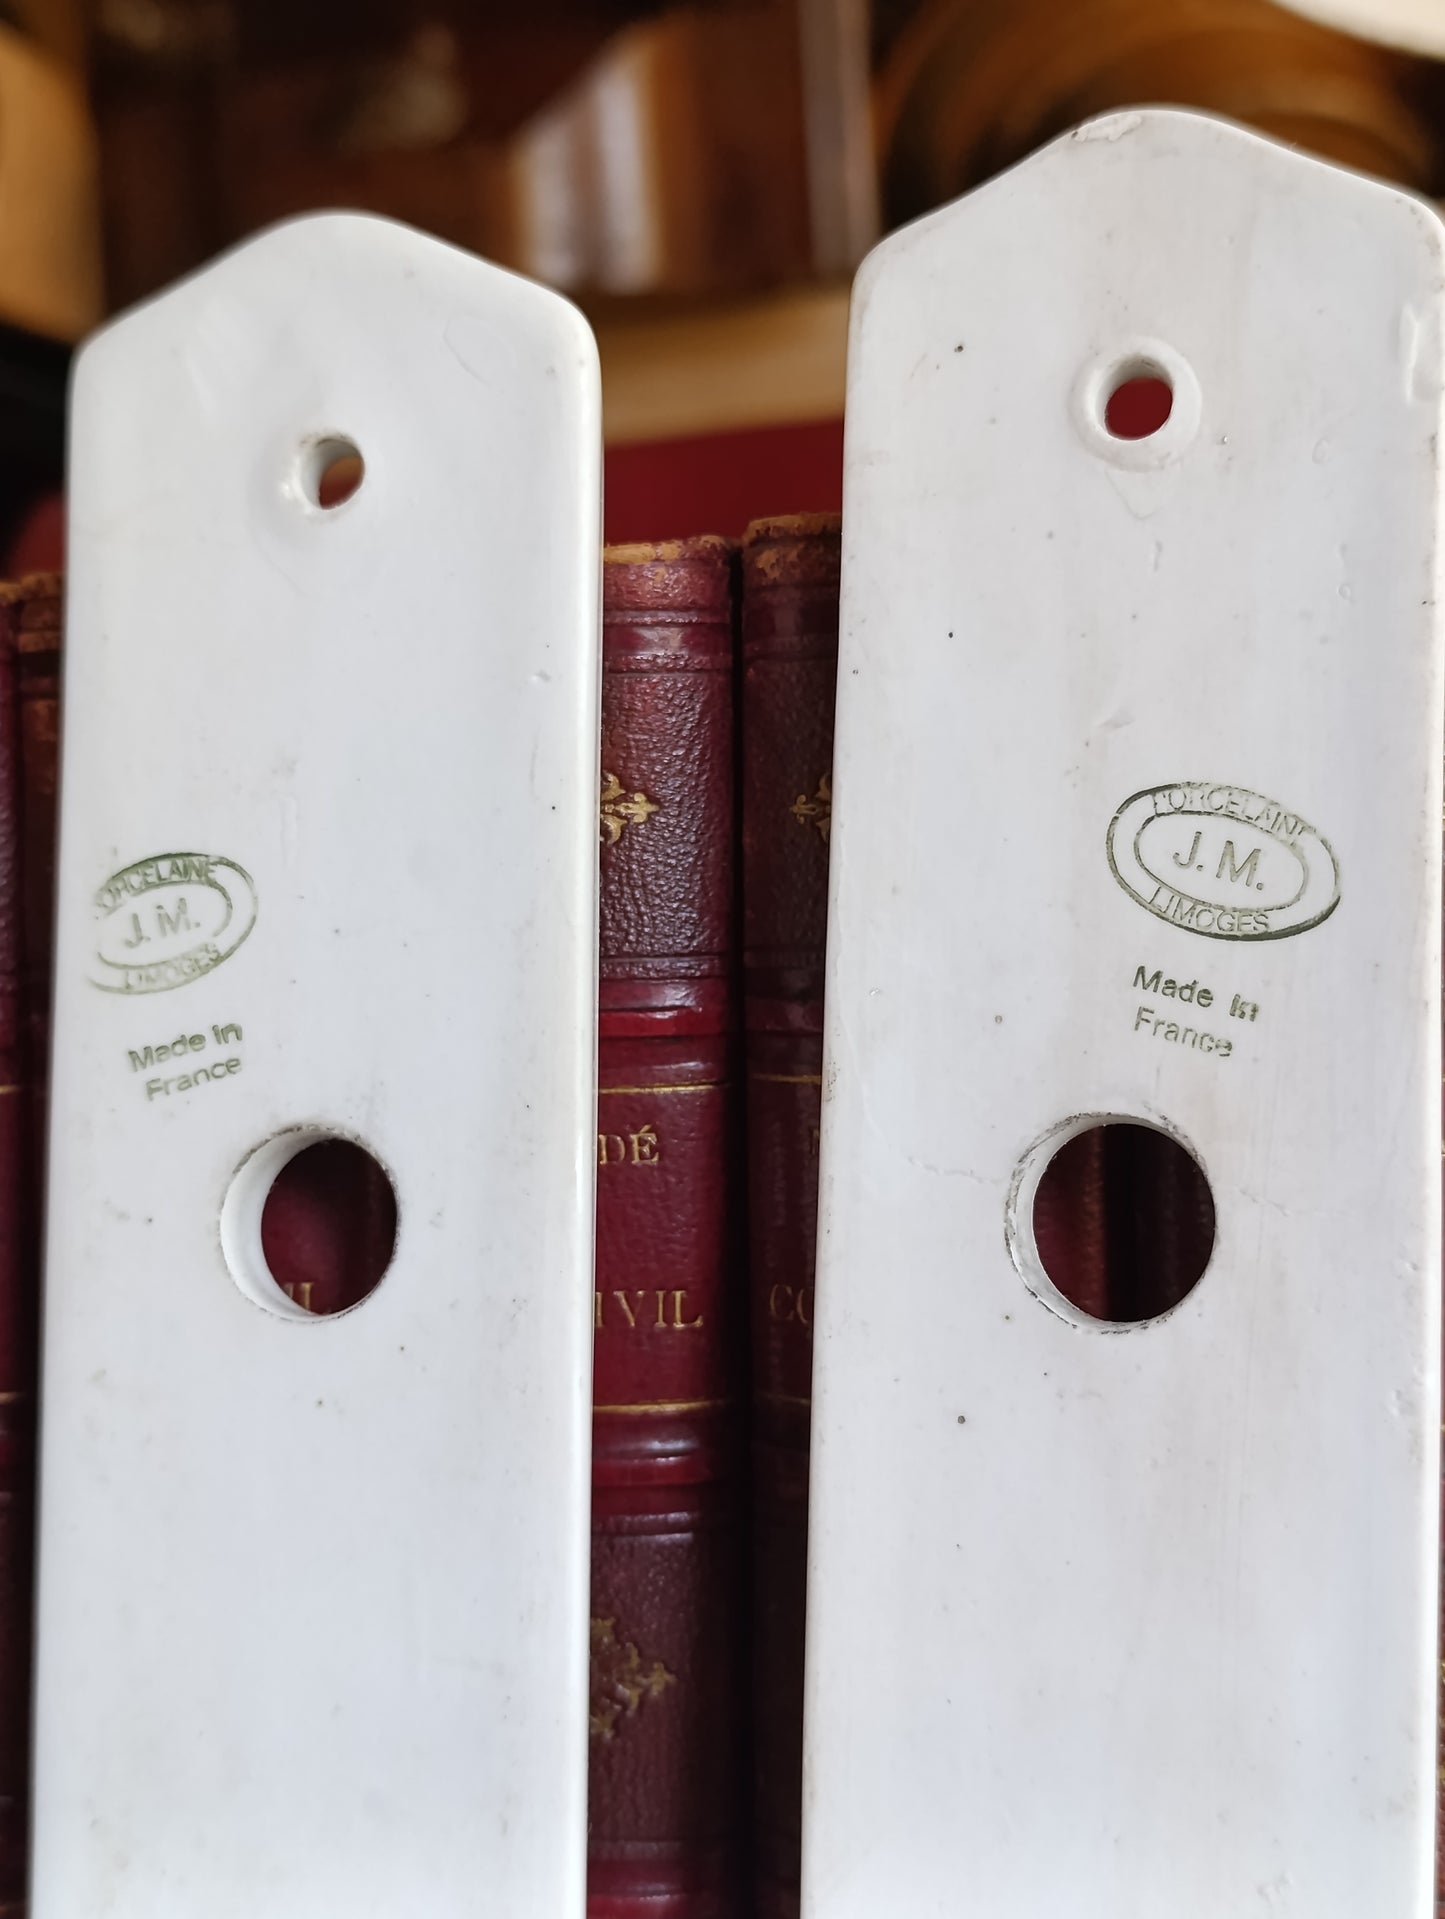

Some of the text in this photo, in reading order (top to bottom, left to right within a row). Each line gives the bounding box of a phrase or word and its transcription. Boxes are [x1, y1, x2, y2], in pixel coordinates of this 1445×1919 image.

[94, 858, 216, 912] ORCELAINE
[1172, 831, 1265, 891] J. M.
[124, 896, 202, 949] J. M.
[1147, 885, 1270, 934] LIMOGES
[1131, 965, 1214, 1009] Made
[128, 1033, 207, 1073] Made
[1133, 1005, 1234, 1058] France
[145, 1057, 242, 1102] France
